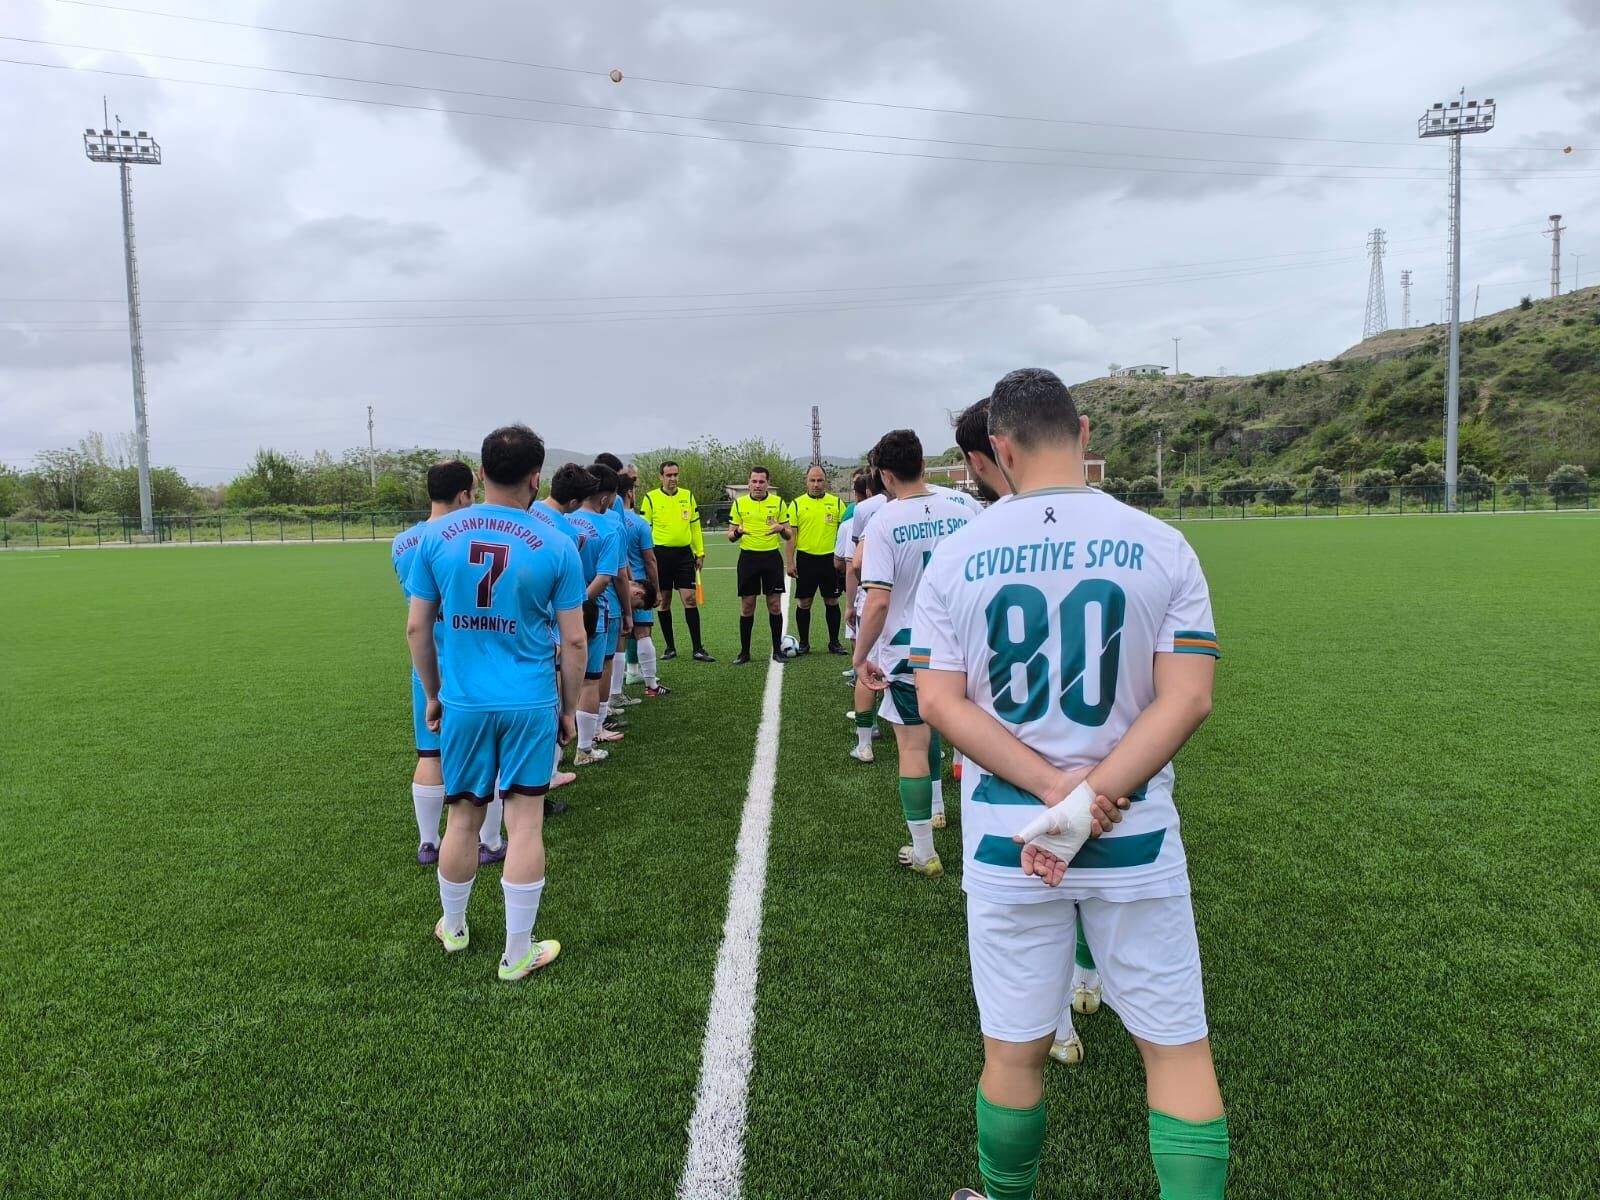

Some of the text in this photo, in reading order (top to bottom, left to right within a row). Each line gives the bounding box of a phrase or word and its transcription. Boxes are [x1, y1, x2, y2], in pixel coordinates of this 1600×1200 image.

[468, 539, 511, 609] 7
[964, 537, 1076, 582] CEVDETİYE
[1084, 539, 1145, 571] SPOR
[452, 614, 517, 635] OSMANİYE
[984, 578, 1127, 728] 80
